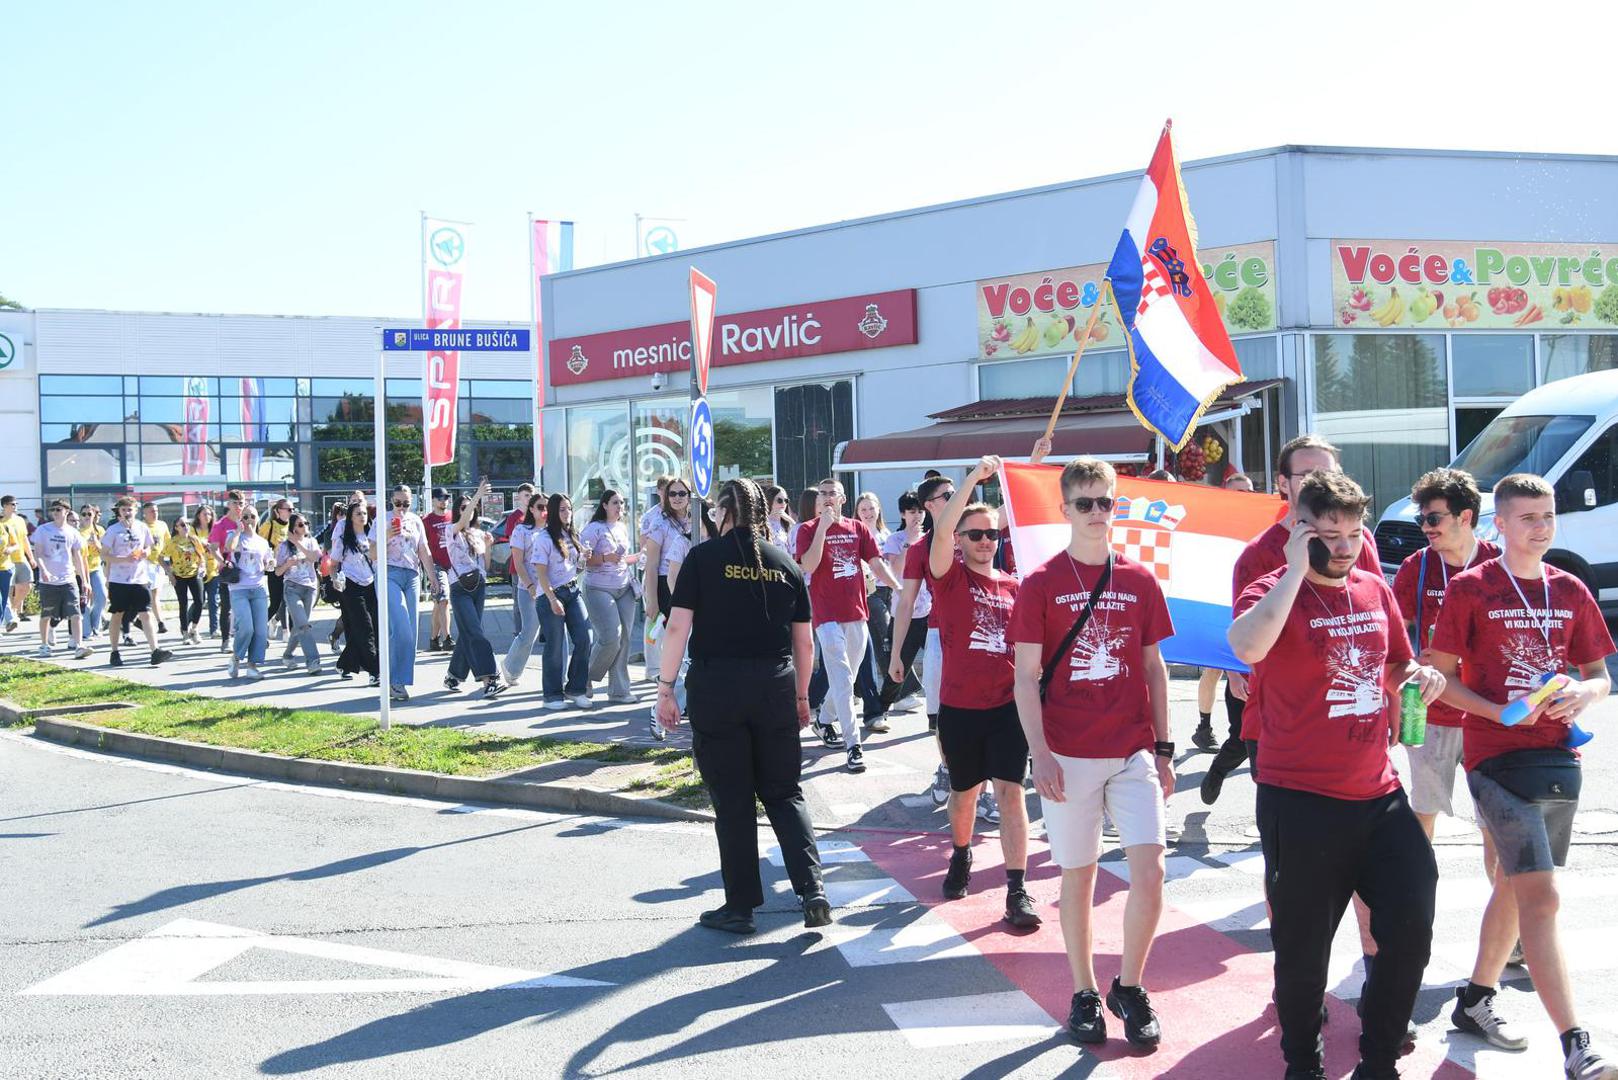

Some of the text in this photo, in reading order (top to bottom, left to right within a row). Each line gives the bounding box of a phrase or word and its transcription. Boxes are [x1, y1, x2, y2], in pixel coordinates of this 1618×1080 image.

[413, 331, 518, 347] ULICA BRUNE BUŠIĆA
[613, 337, 692, 369] mesnic
[1055, 591, 1091, 604] OSTAVITE
[1070, 604, 1079, 612] VI
[1488, 608, 1526, 619] OSTAVITE
[1554, 608, 1573, 619] NADU
[1309, 615, 1346, 629] OSTAVITE
[1347, 612, 1372, 624] SVAKU
[1504, 620, 1513, 629] VI
[1514, 620, 1530, 629] KOJI
